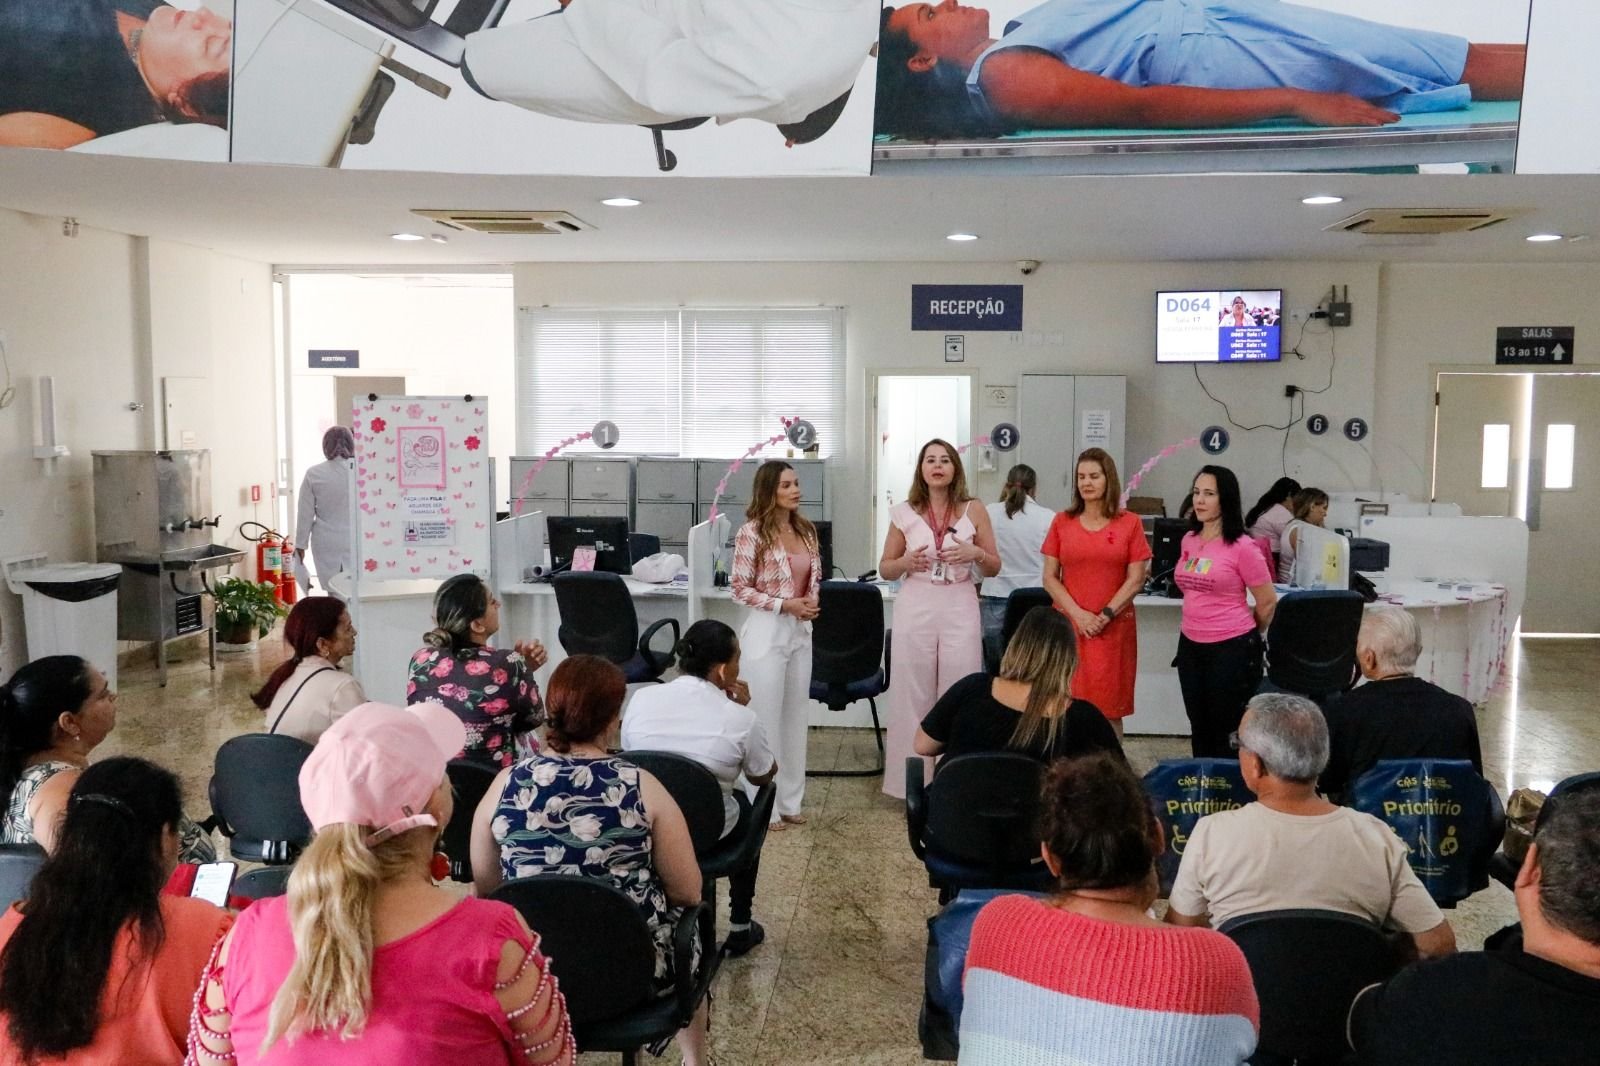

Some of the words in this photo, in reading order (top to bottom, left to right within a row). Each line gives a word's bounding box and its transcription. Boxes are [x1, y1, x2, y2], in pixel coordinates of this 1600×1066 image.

[930, 297, 1005, 319] RECEPÇÃO
[1166, 298, 1211, 312] D064
[1522, 328, 1553, 338] SALAS
[1503, 346, 1516, 357] 13
[1518, 348, 1530, 357] ao
[1534, 346, 1546, 357] 19
[1313, 418, 1322, 431] 6
[1351, 422, 1360, 437] 5
[600, 426, 609, 444] 1
[797, 426, 808, 443] 2
[1000, 428, 1011, 447] 3
[1209, 431, 1221, 450] 4
[1383, 798, 1461, 816] Prioritrio
